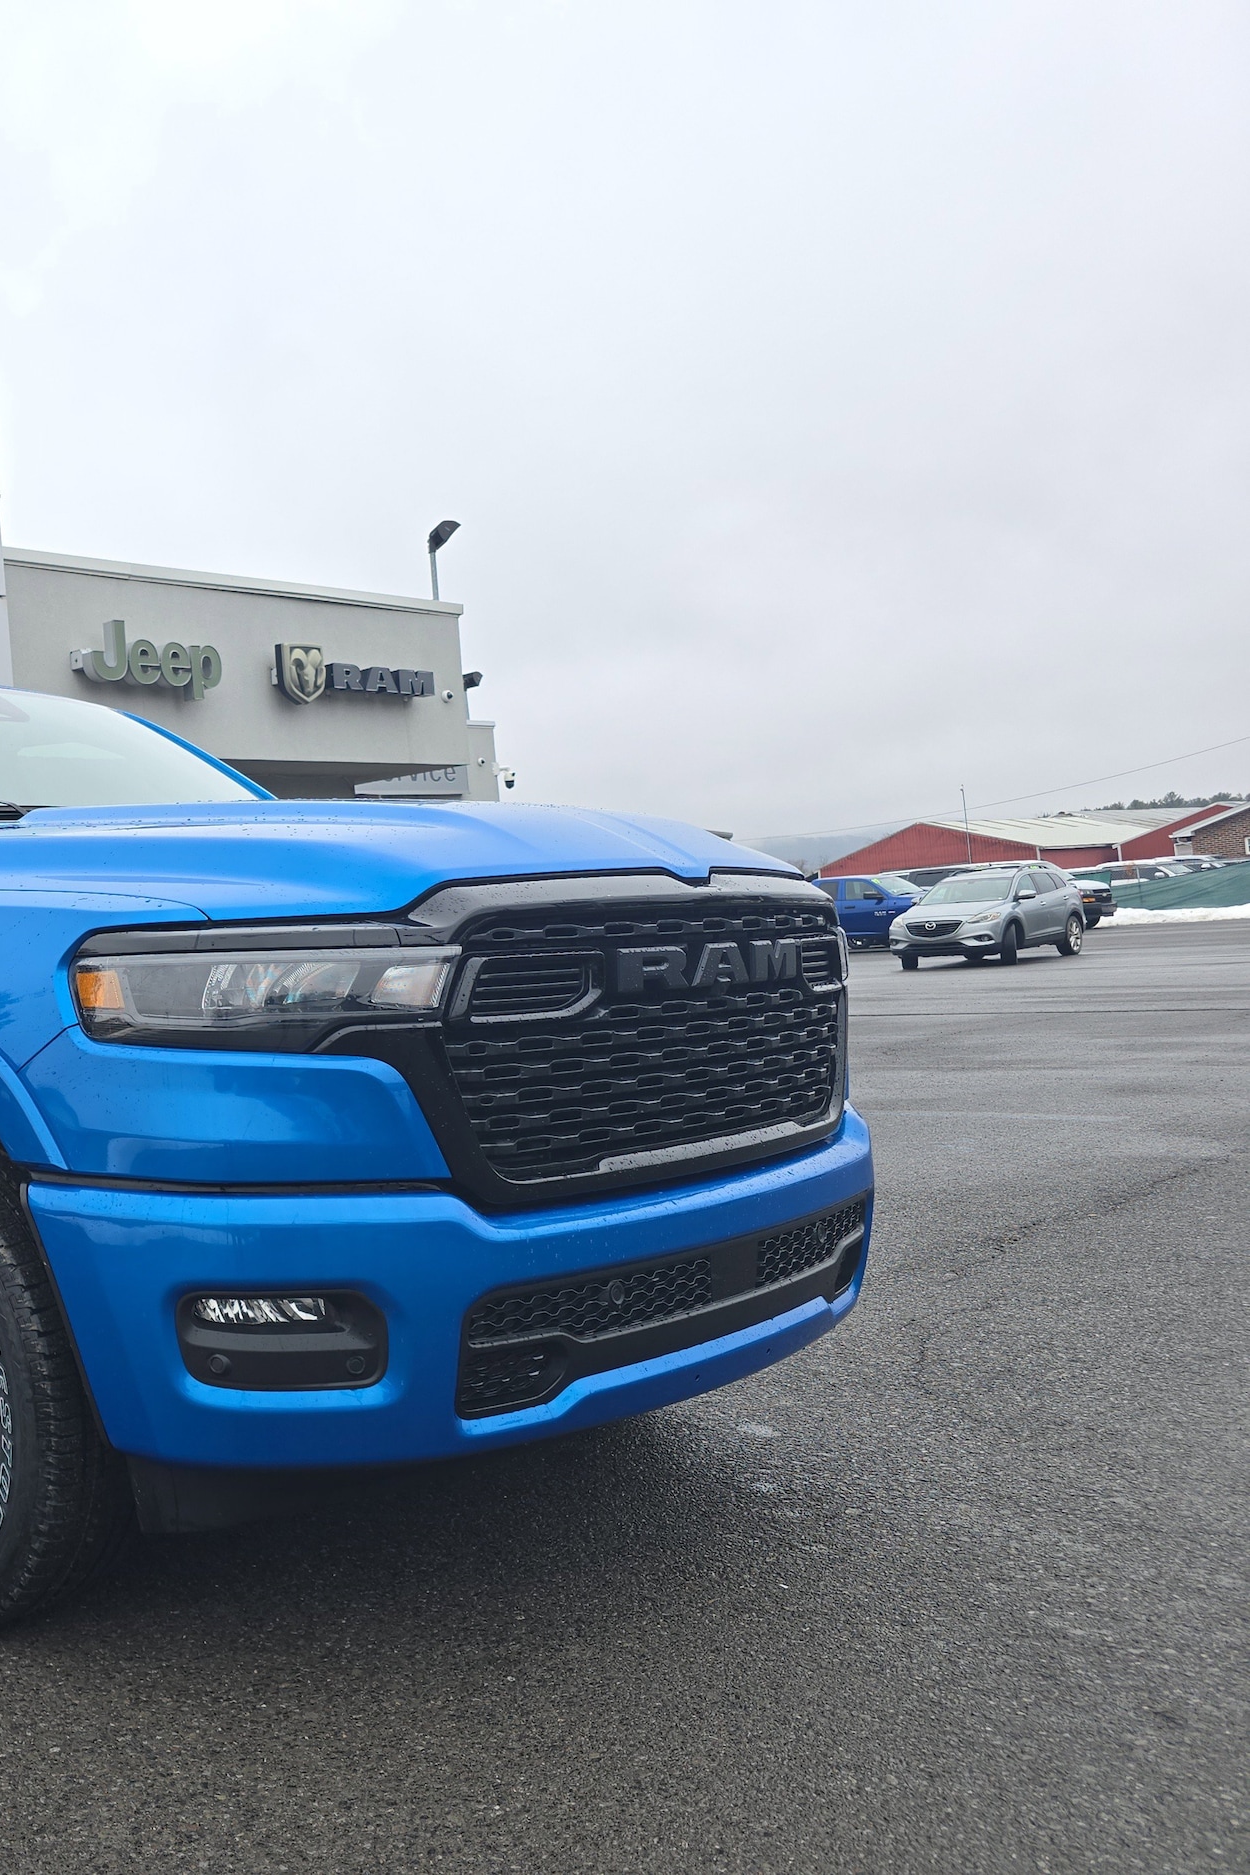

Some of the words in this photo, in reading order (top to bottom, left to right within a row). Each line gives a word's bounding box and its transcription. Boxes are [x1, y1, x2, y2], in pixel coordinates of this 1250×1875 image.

[82, 619, 222, 700] Jeep
[326, 662, 435, 697] RAM
[616, 938, 797, 994] RAM
